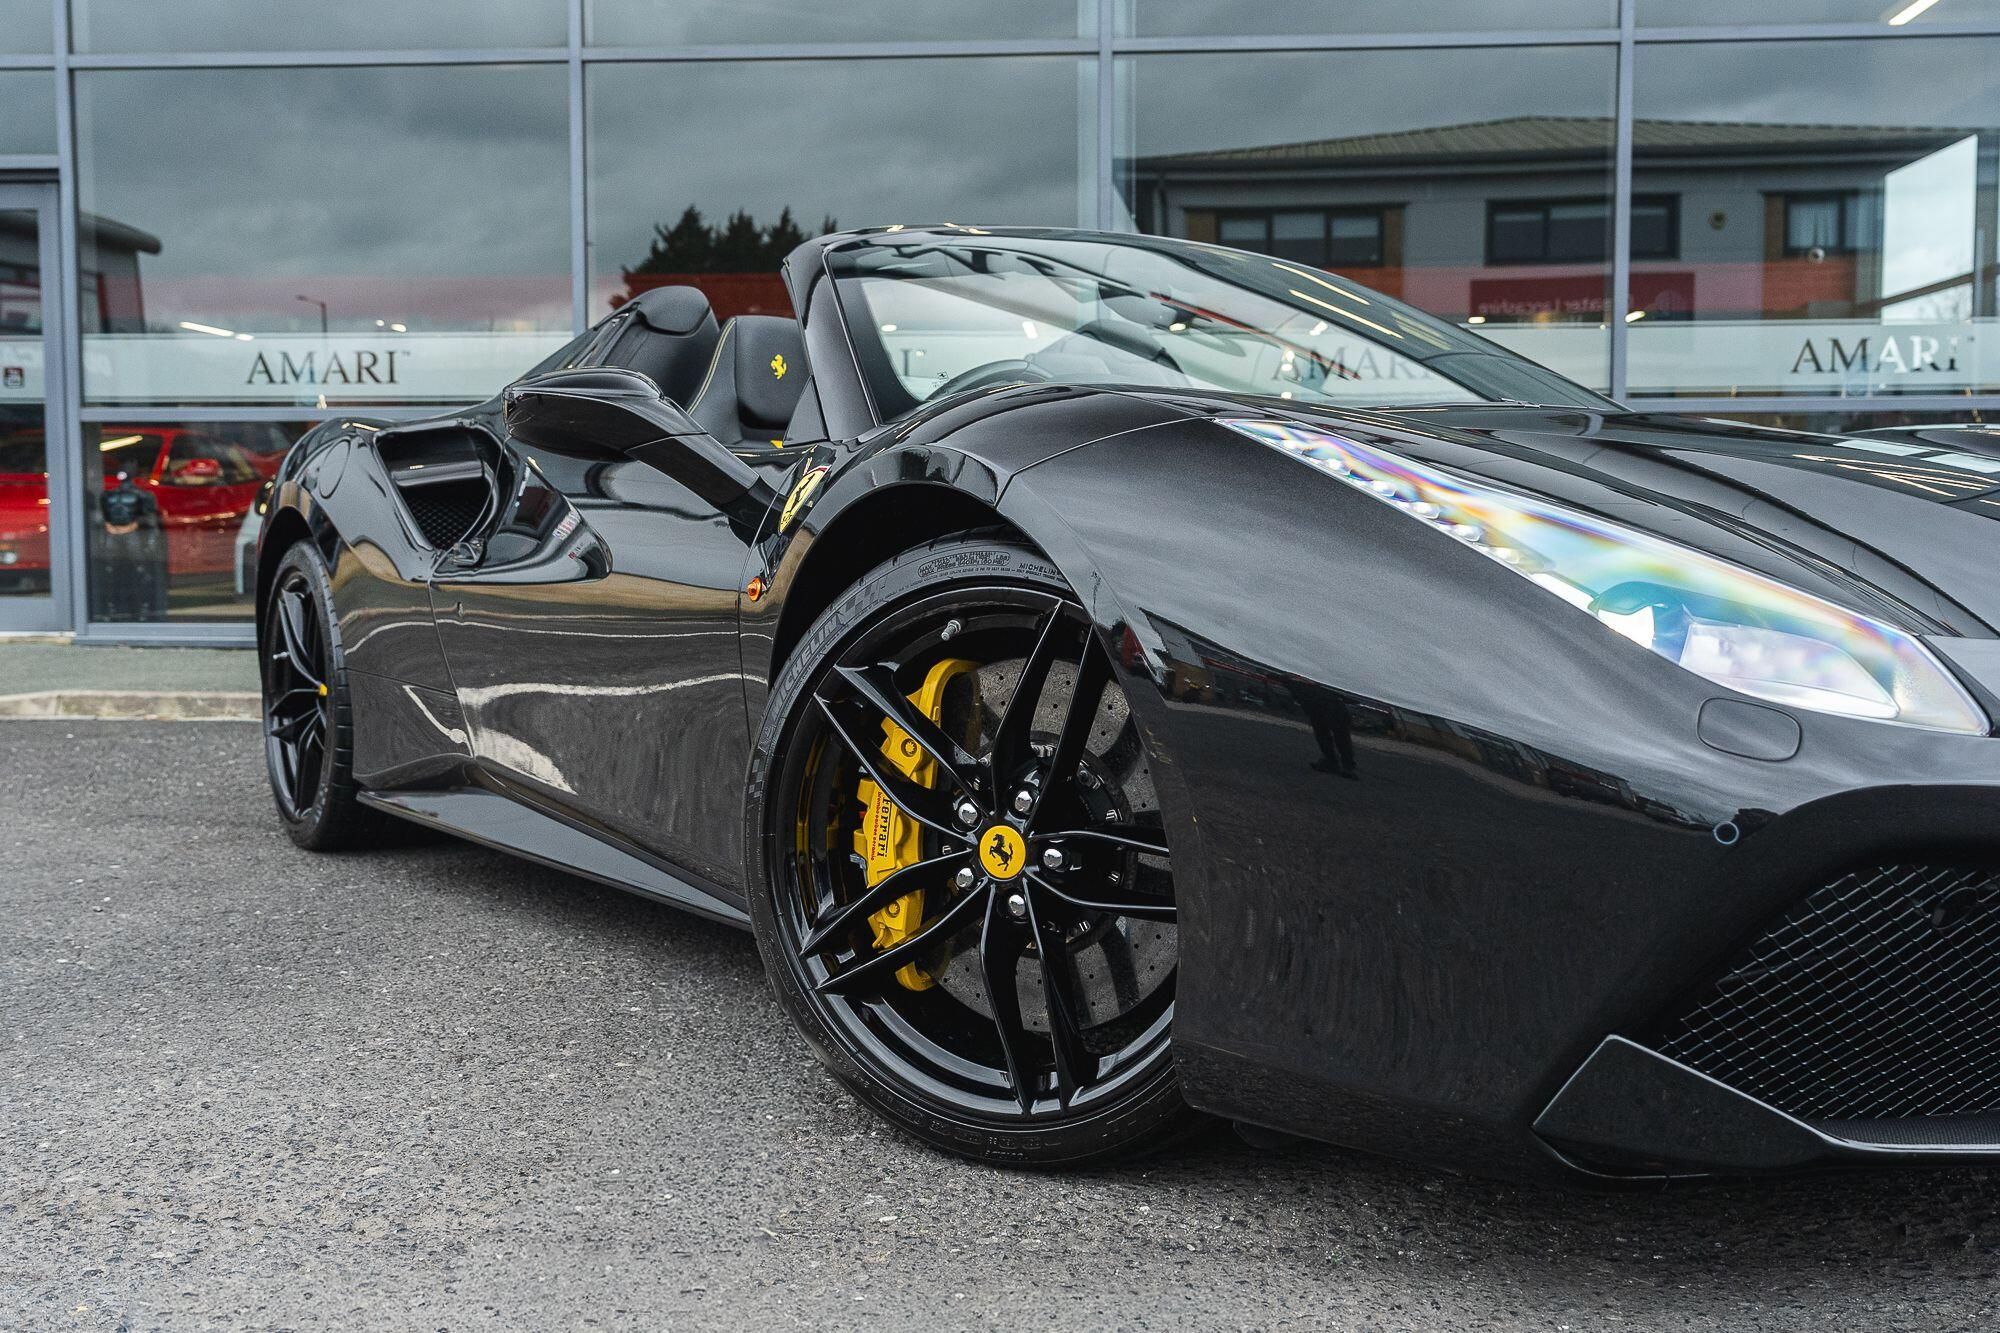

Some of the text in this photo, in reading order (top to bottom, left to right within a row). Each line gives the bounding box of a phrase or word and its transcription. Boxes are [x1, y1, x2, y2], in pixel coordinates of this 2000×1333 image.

[1018, 562, 1057, 576] MICHELIN
[768, 611, 847, 723] MICHELIN
[877, 797, 893, 858] Ferrari
